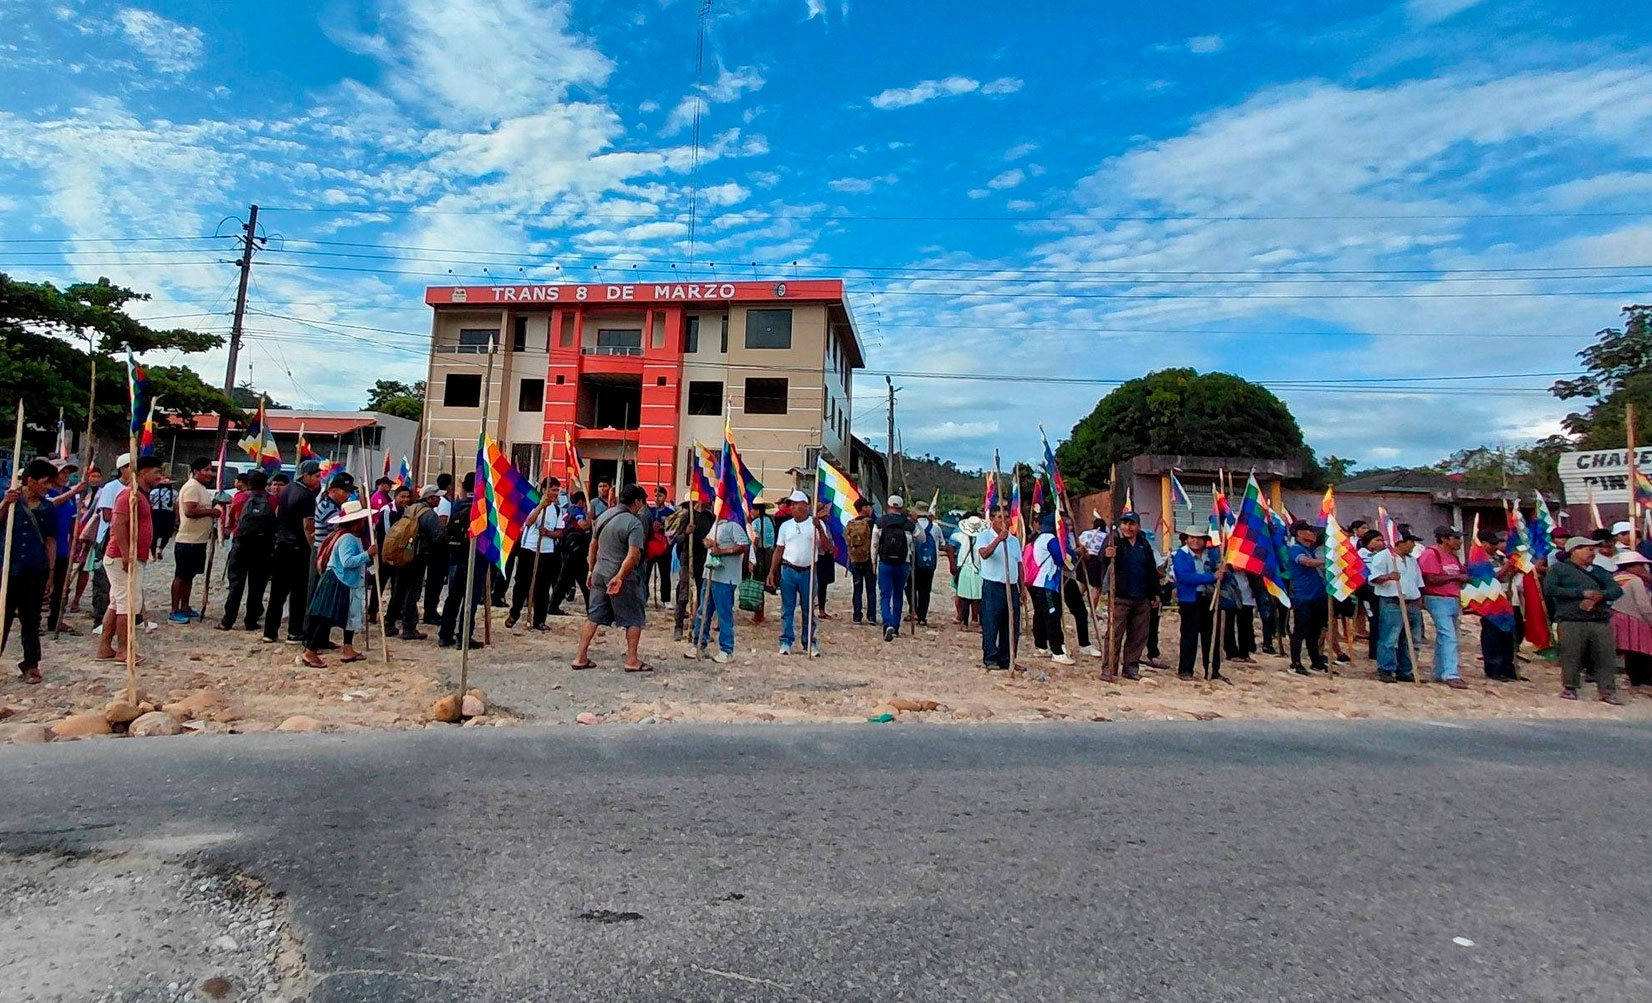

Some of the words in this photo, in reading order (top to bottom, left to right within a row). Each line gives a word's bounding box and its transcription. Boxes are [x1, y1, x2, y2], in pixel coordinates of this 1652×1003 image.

[492, 286, 559, 301] TRANS
[576, 286, 587, 300] 8
[606, 285, 634, 300] DE
[654, 283, 735, 299] MARZO
